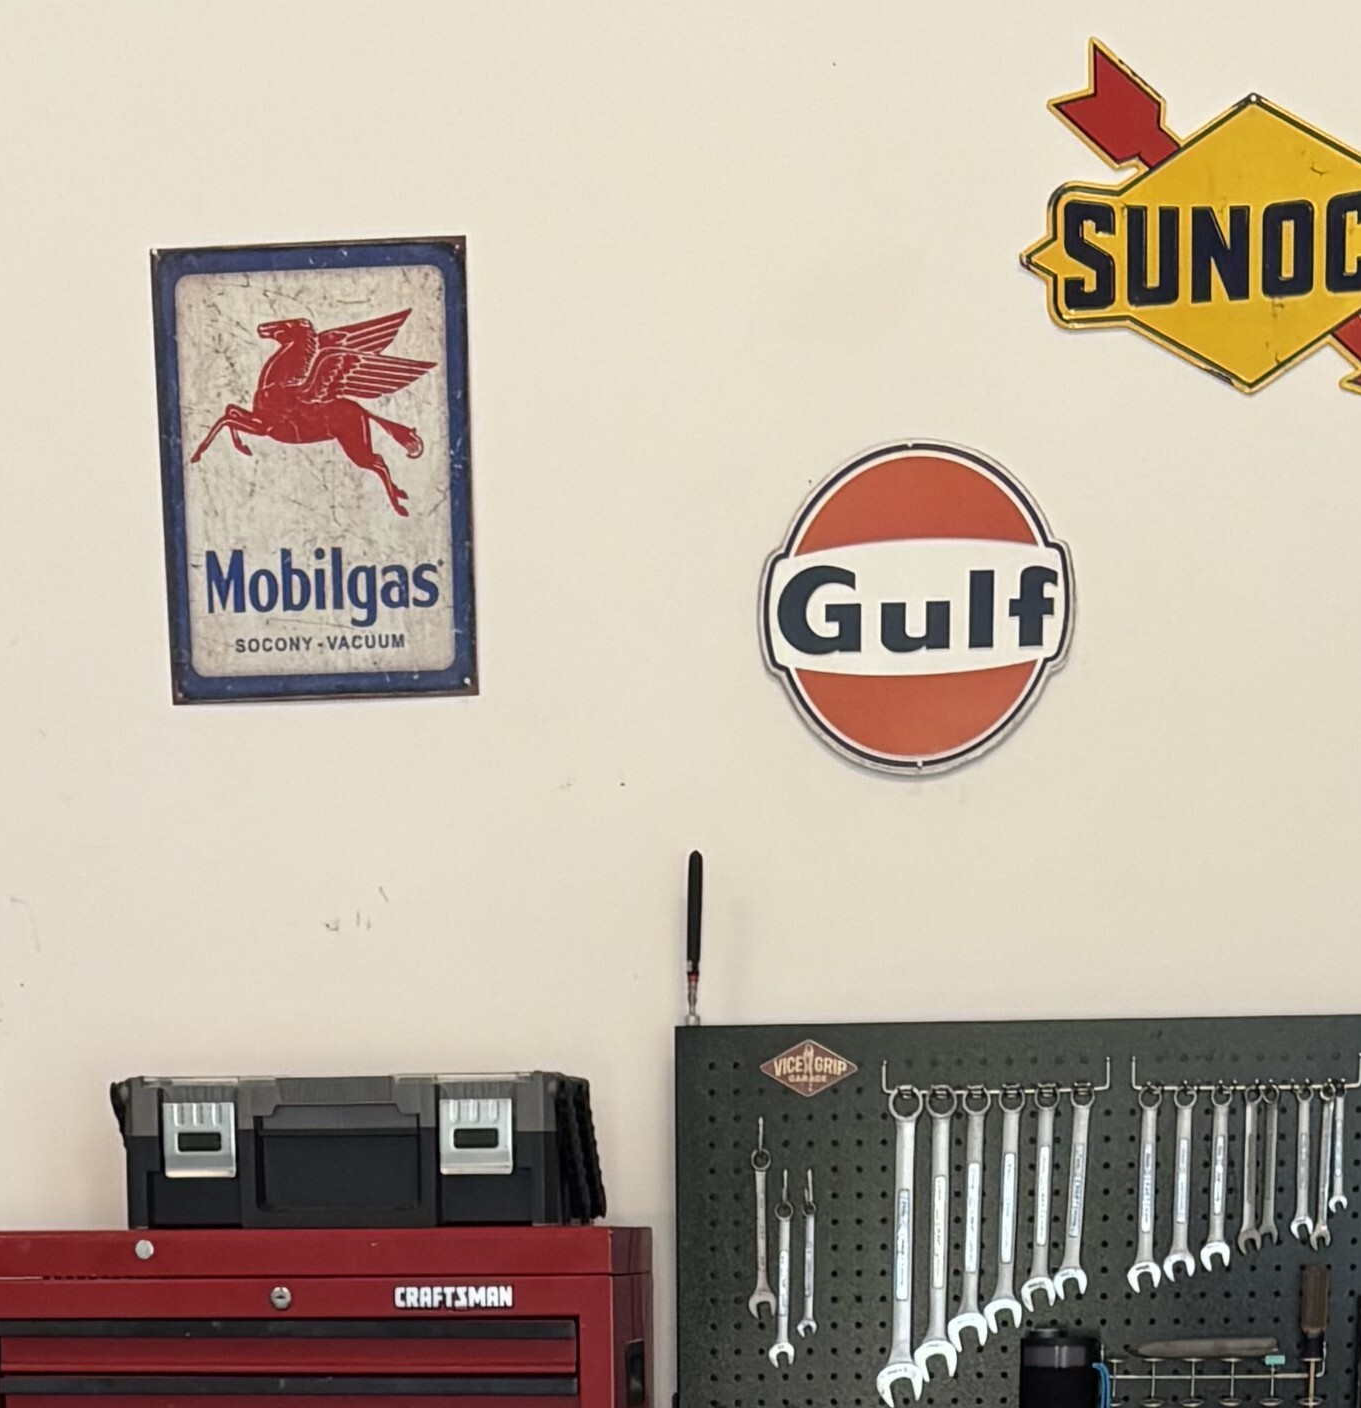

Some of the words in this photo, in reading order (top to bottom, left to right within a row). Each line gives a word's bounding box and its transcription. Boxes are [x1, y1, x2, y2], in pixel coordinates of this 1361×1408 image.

[206, 547, 440, 628] Mobilgas
[777, 564, 1058, 655] Gulf
[773, 1056, 804, 1077] VICE
[814, 1056, 848, 1076] GRIP
[394, 1285, 513, 1308] CRAFTSMAN
